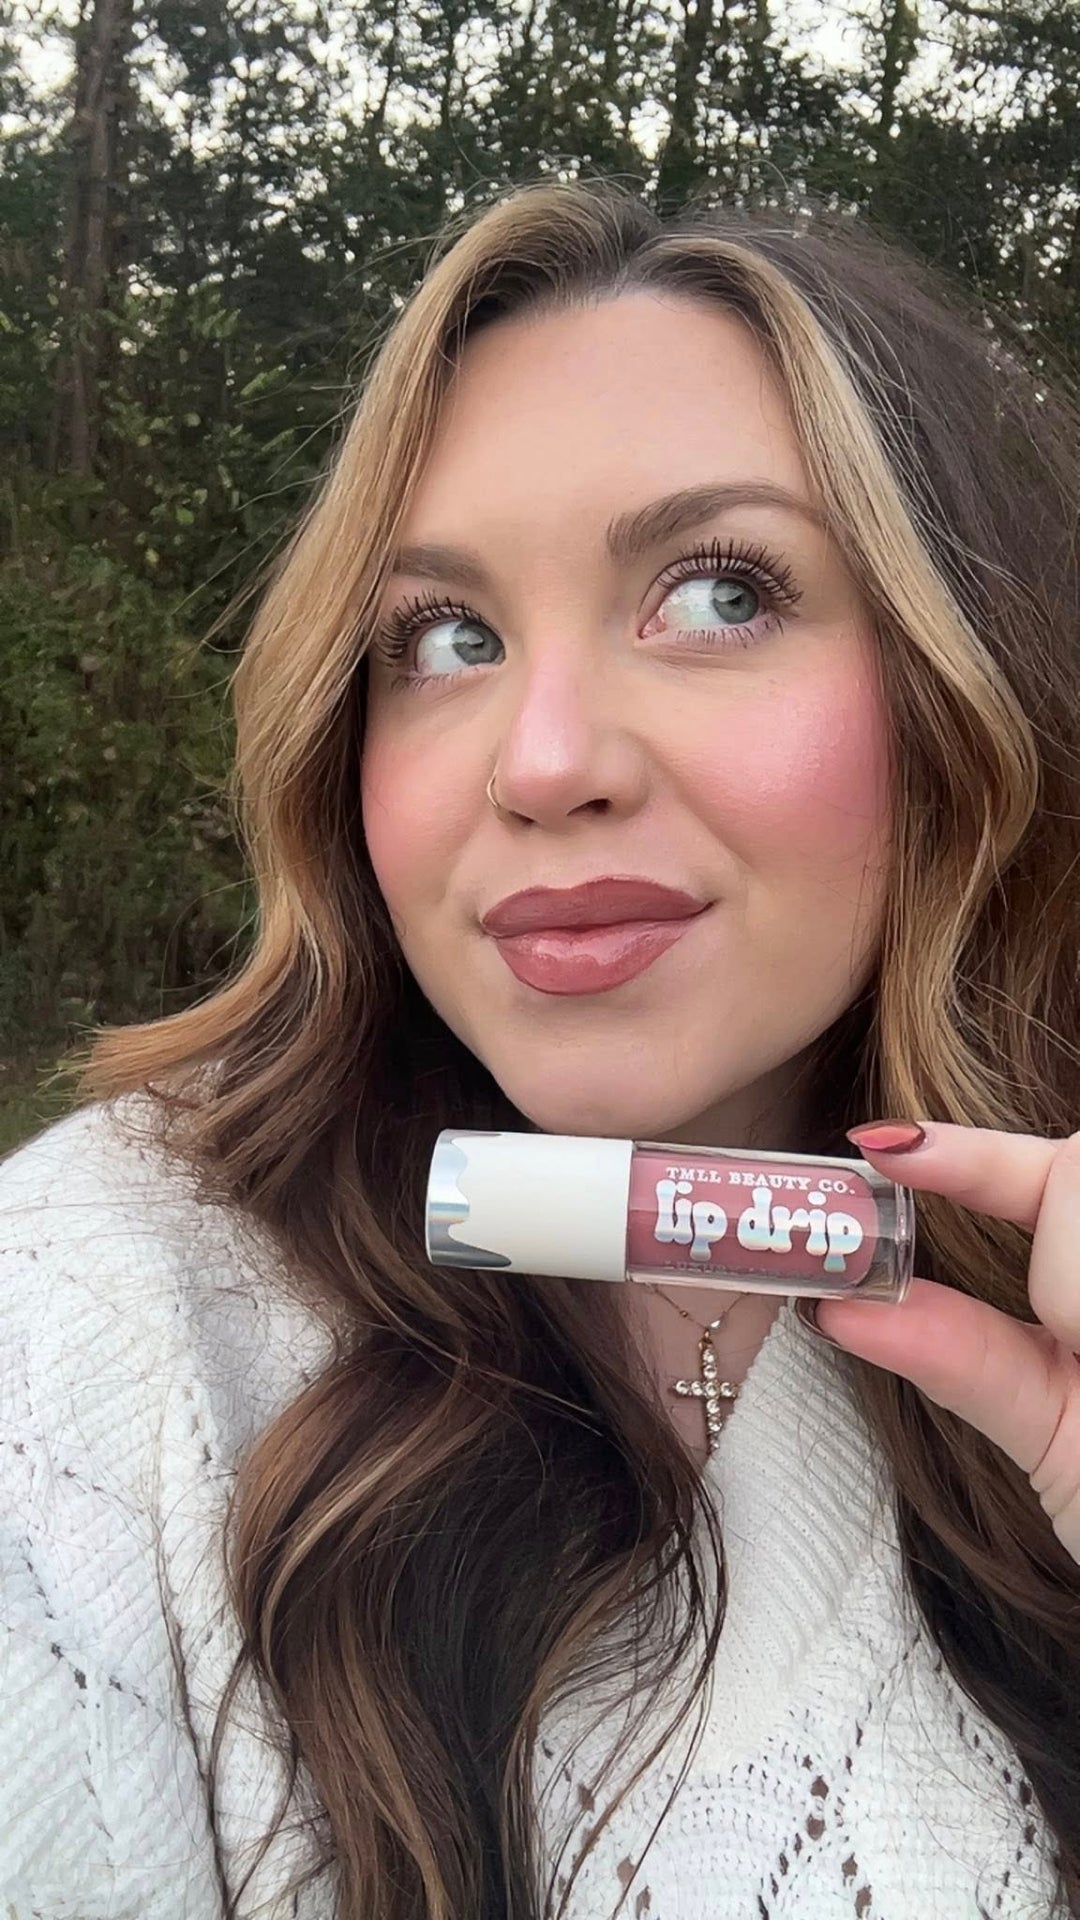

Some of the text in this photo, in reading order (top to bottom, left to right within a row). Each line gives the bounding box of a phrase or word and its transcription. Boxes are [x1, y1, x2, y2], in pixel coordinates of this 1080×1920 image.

[666, 1166, 856, 1195] TMLL BEAUTY CO.
[654, 1179, 863, 1272] lip drip
